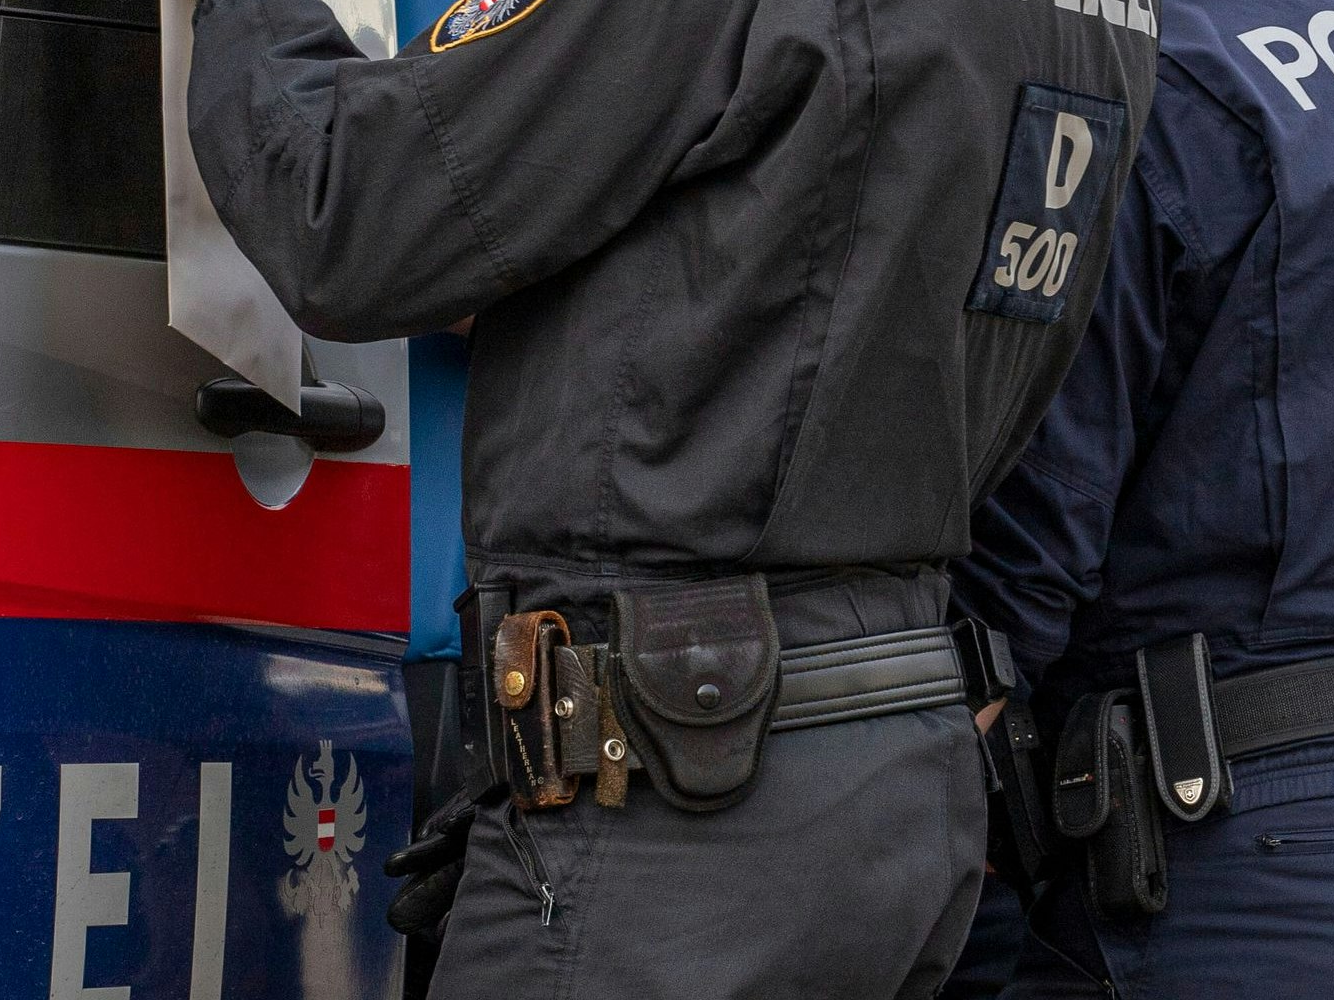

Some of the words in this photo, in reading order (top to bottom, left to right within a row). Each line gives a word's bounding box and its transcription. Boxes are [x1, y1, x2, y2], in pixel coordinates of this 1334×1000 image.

[1045, 111, 1093, 210] D
[994, 221, 1078, 297] 500
[510, 717, 537, 787] LEATHERMAN
